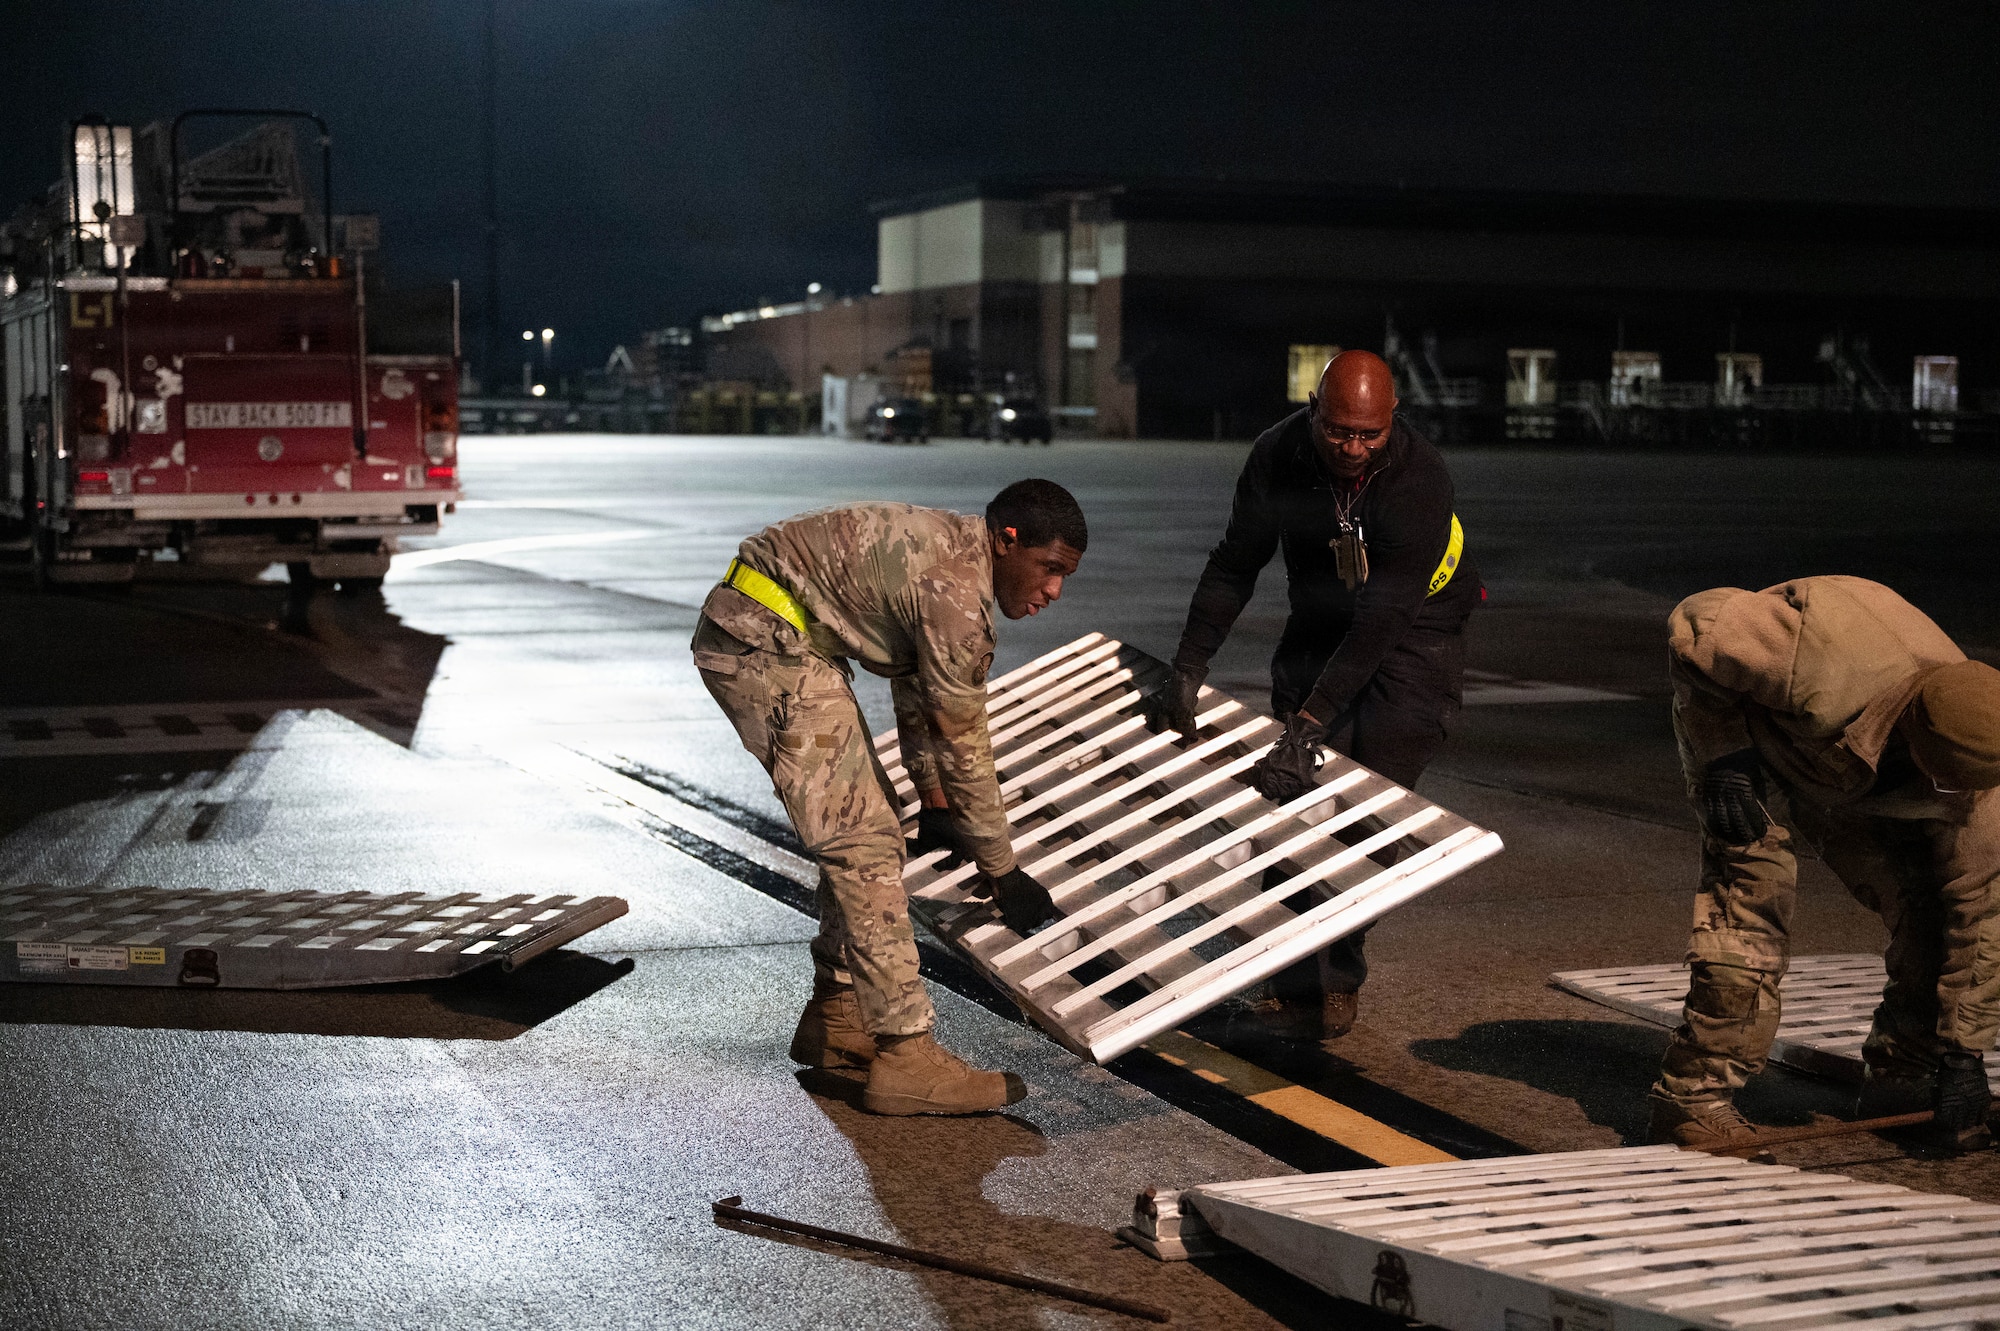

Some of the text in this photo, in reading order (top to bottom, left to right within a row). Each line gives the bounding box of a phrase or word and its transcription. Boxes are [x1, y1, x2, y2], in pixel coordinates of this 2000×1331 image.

[70, 291, 114, 329] L-1
[193, 404, 231, 427] STAY
[238, 404, 278, 427] BACK
[286, 404, 317, 426] 500
